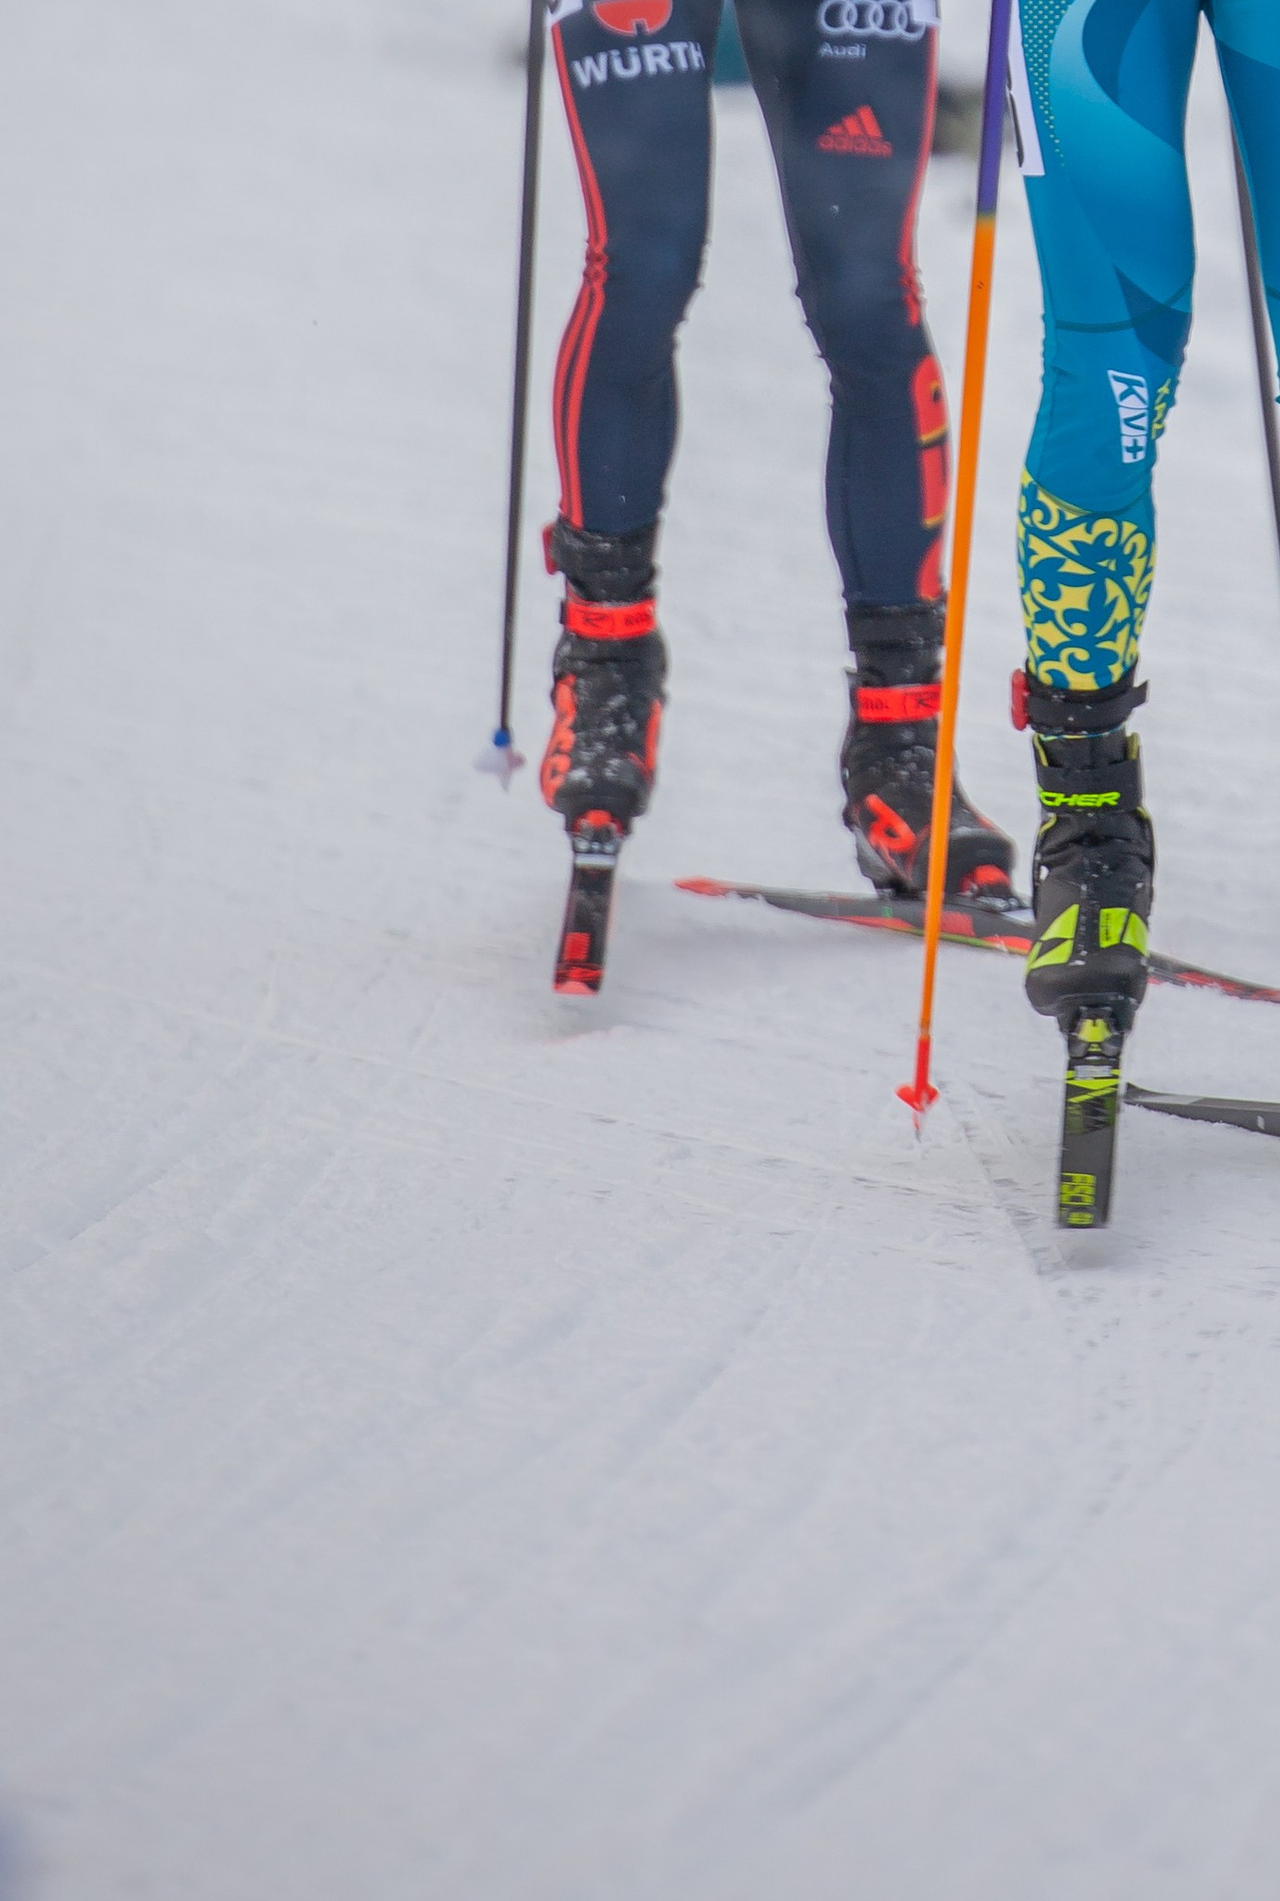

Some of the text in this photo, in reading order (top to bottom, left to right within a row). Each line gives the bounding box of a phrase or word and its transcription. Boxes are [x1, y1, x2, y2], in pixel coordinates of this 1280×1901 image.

[819, 42, 867, 58] Audi
[571, 41, 706, 88] WÜRTH
[1038, 790, 1121, 807] CHER
